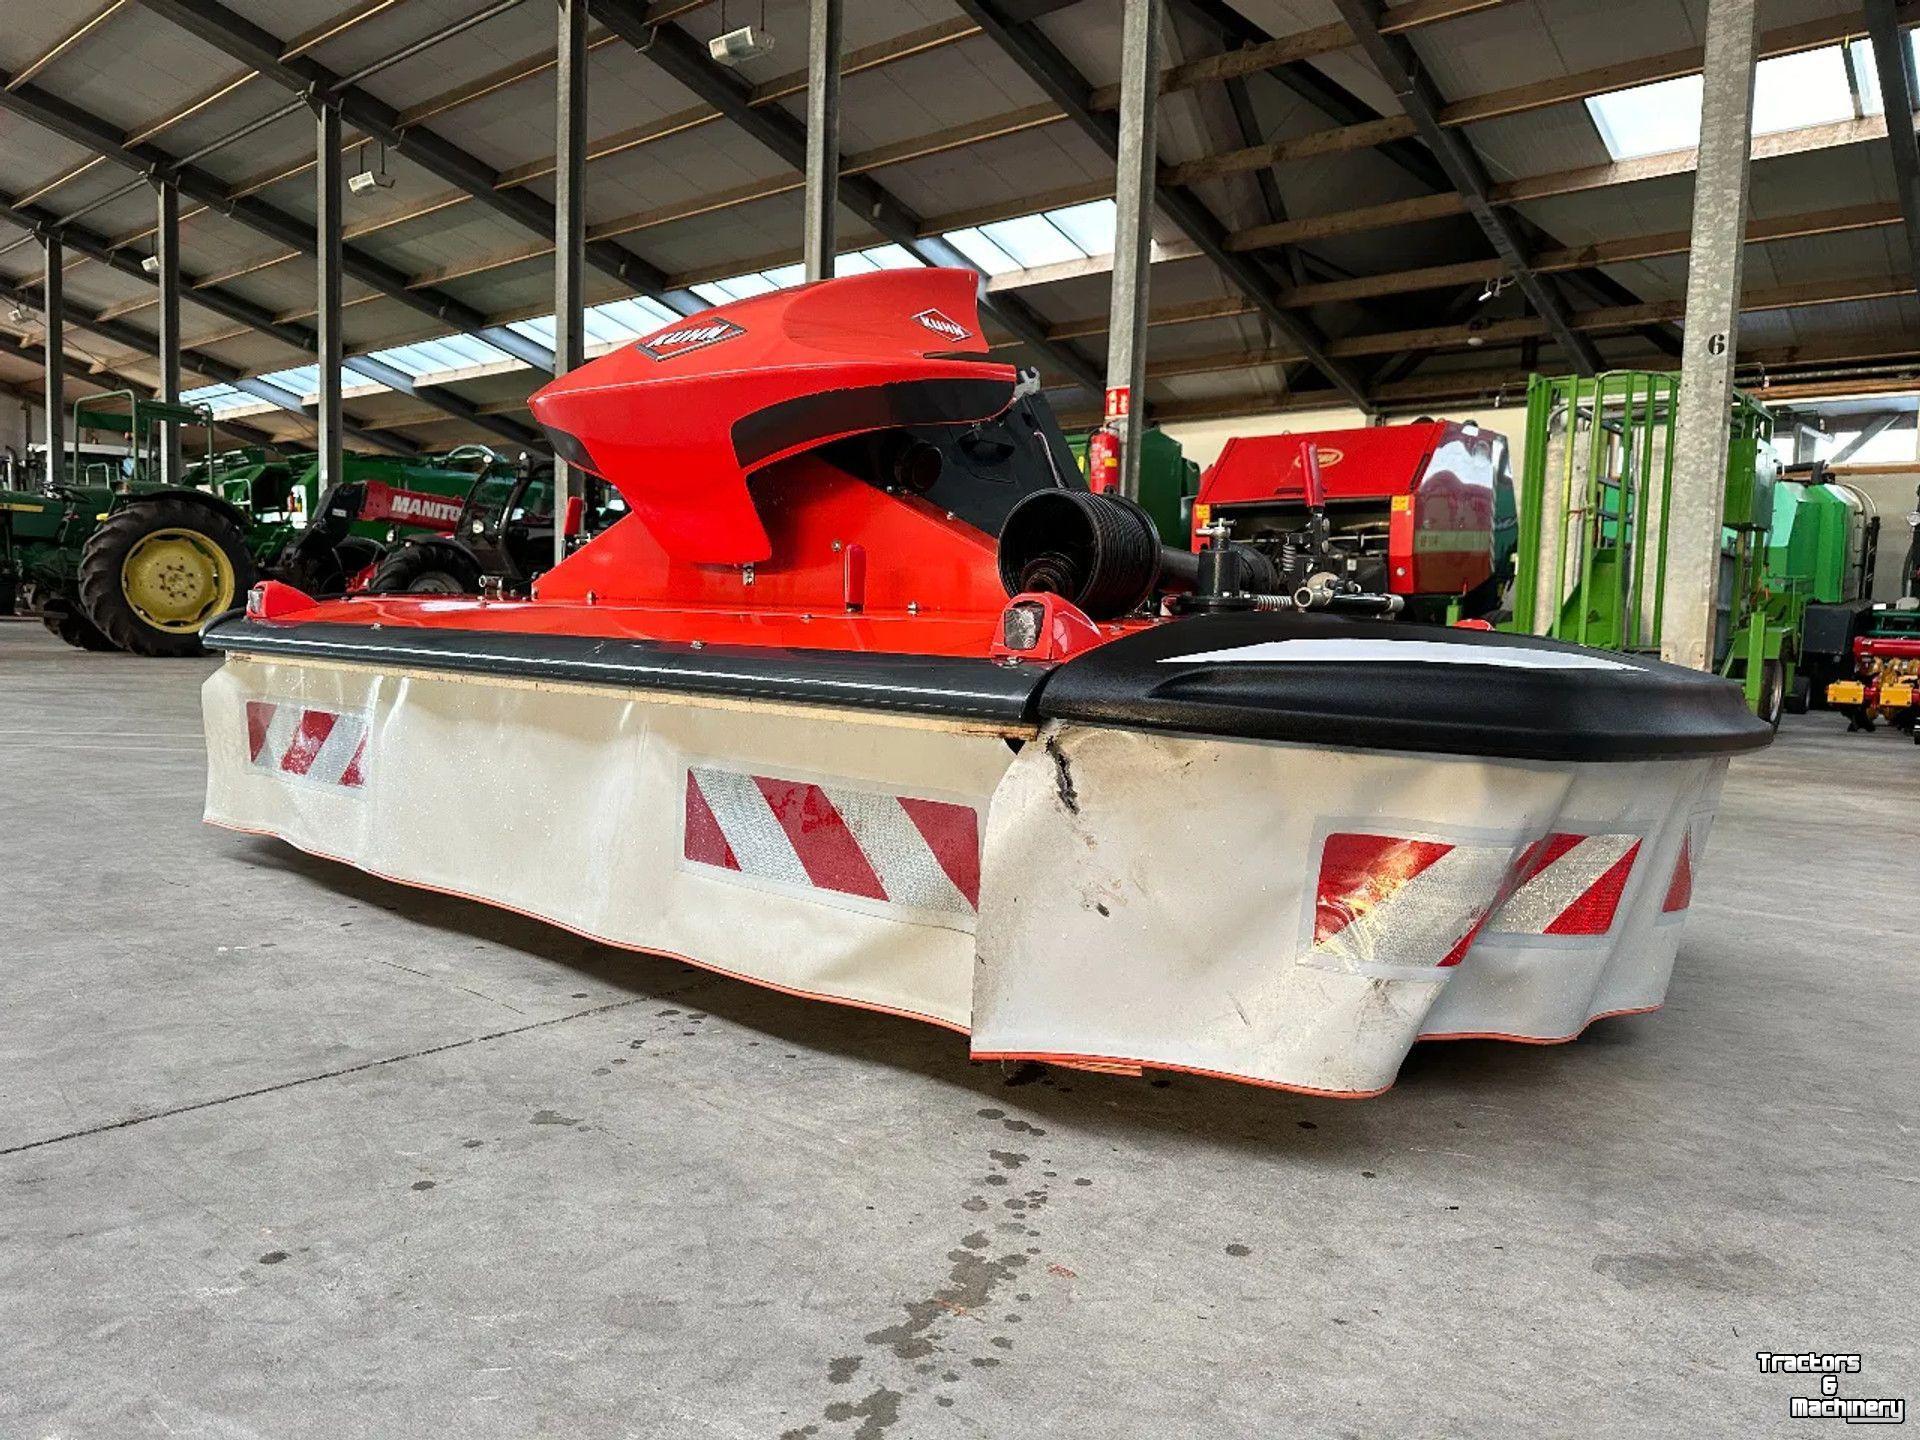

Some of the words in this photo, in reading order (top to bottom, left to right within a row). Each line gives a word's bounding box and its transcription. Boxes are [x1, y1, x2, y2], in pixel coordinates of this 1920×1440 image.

[645, 324, 731, 348] KUHN
[919, 316, 966, 337] KUHN
[1708, 334, 1725, 355] 6
[391, 495, 463, 521] MANITO
